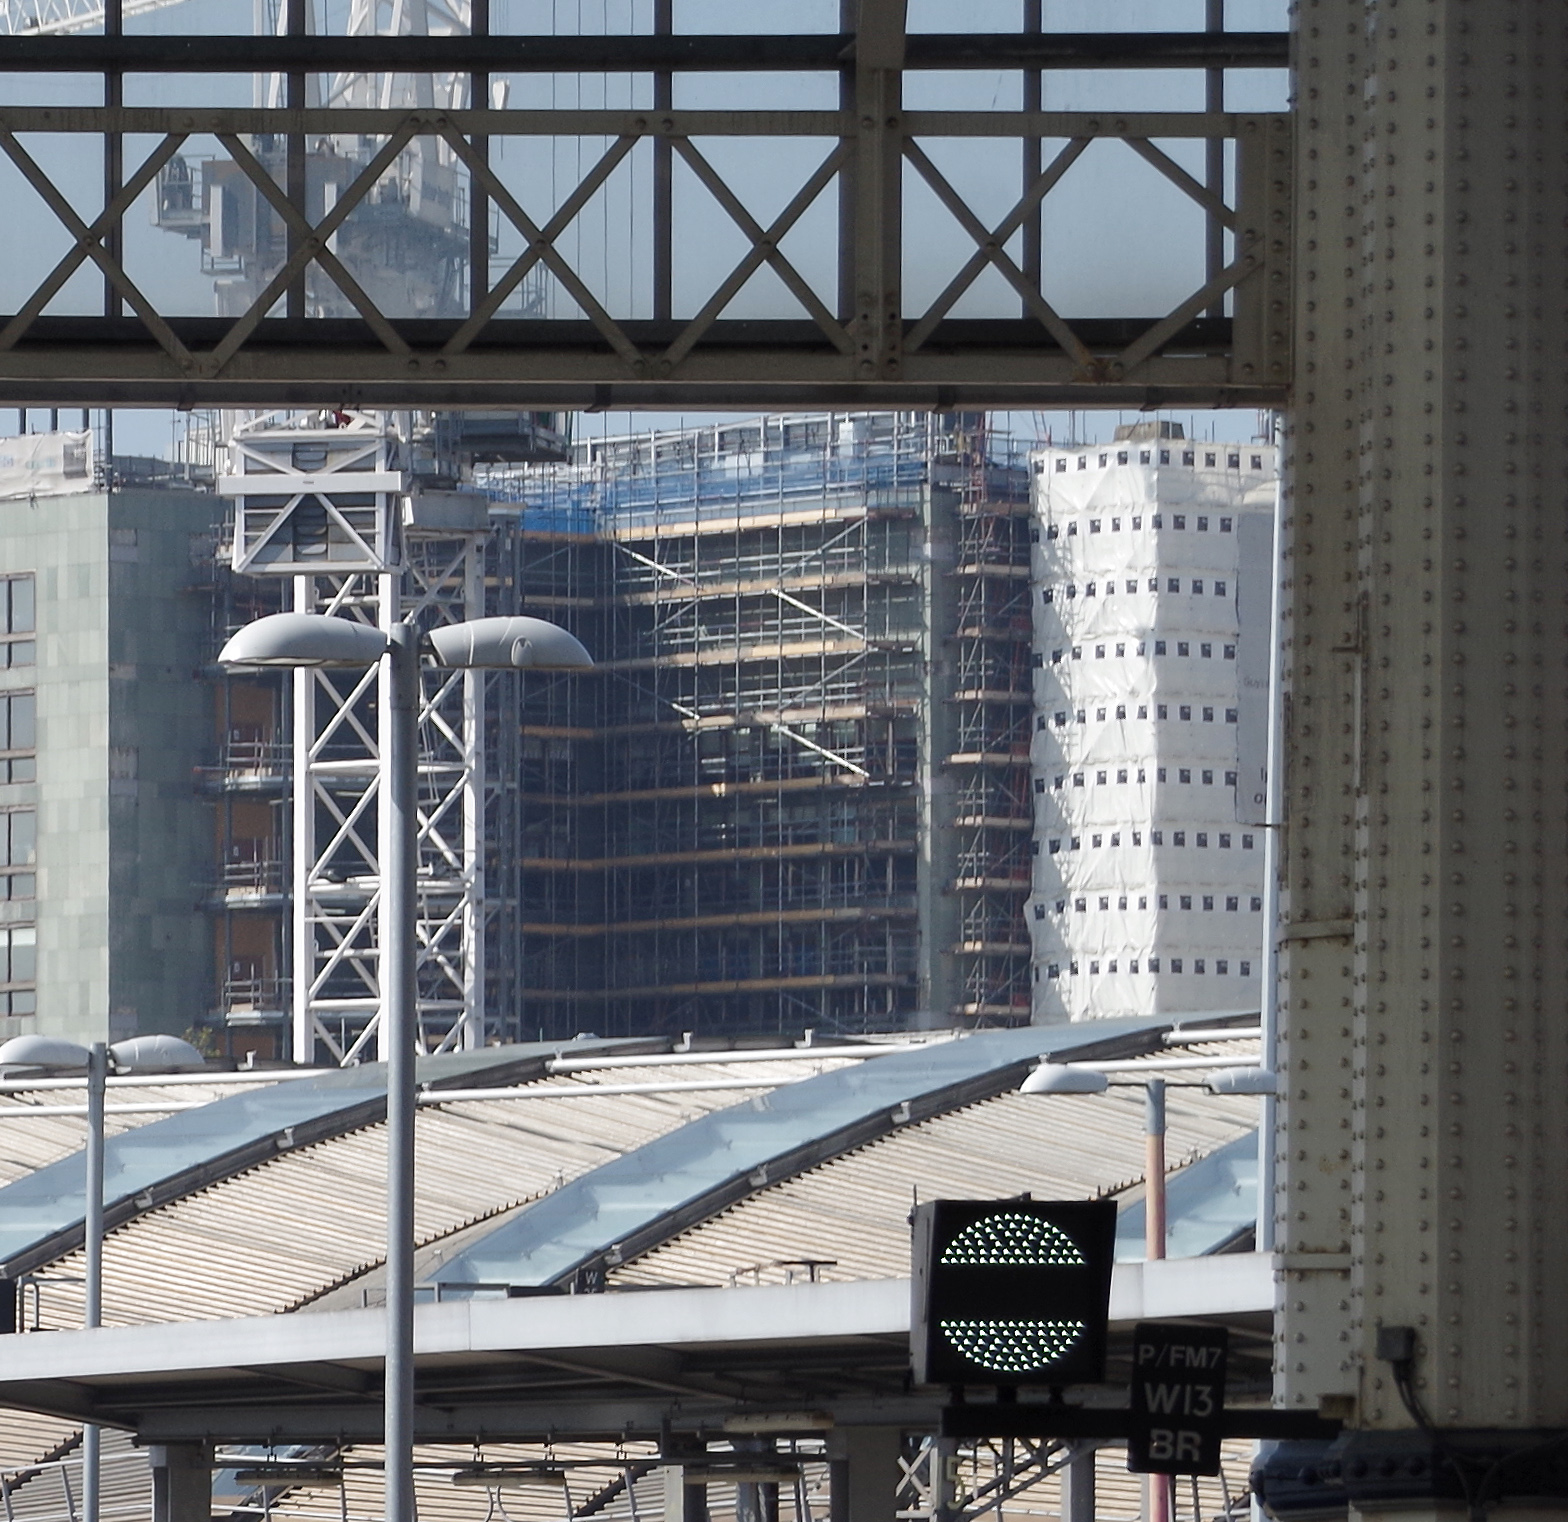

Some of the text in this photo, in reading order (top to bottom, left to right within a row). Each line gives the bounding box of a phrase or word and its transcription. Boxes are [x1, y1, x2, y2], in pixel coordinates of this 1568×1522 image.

[1138, 1344, 1222, 1369] P/FM7
[1144, 1382, 1213, 1417] W13
[1149, 1428, 1202, 1462] BR
